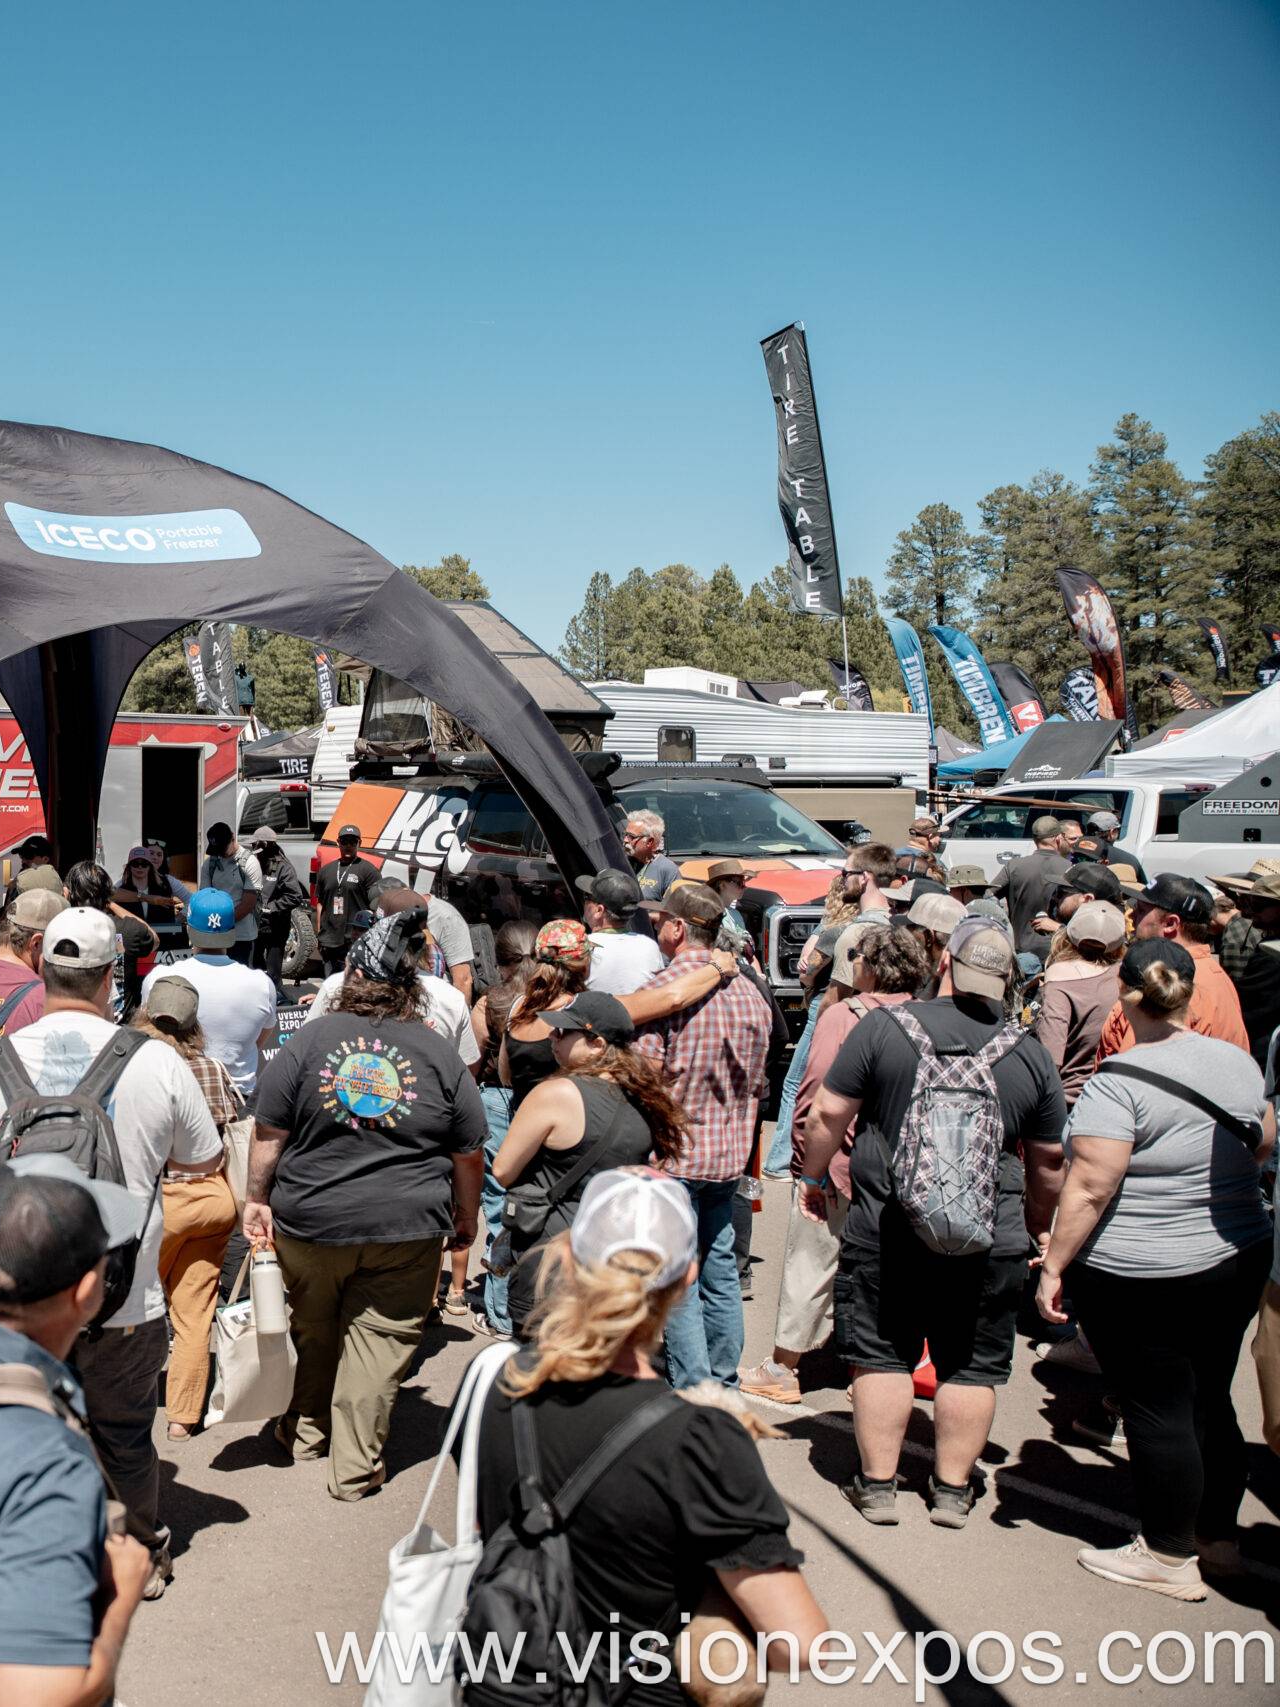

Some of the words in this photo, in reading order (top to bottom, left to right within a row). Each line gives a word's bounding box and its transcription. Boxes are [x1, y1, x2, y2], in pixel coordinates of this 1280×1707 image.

[776, 344, 800, 446] TIRE
[789, 478, 821, 609] TABLE
[34, 519, 156, 551] ICECO
[155, 524, 223, 539] Portable
[163, 537, 220, 550] Freezer
[954, 654, 1007, 745] TIMBREN
[278, 758, 309, 774] TIRE
[1204, 801, 1278, 809] FREEDOM
[279, 1019, 300, 1031] EXPO
